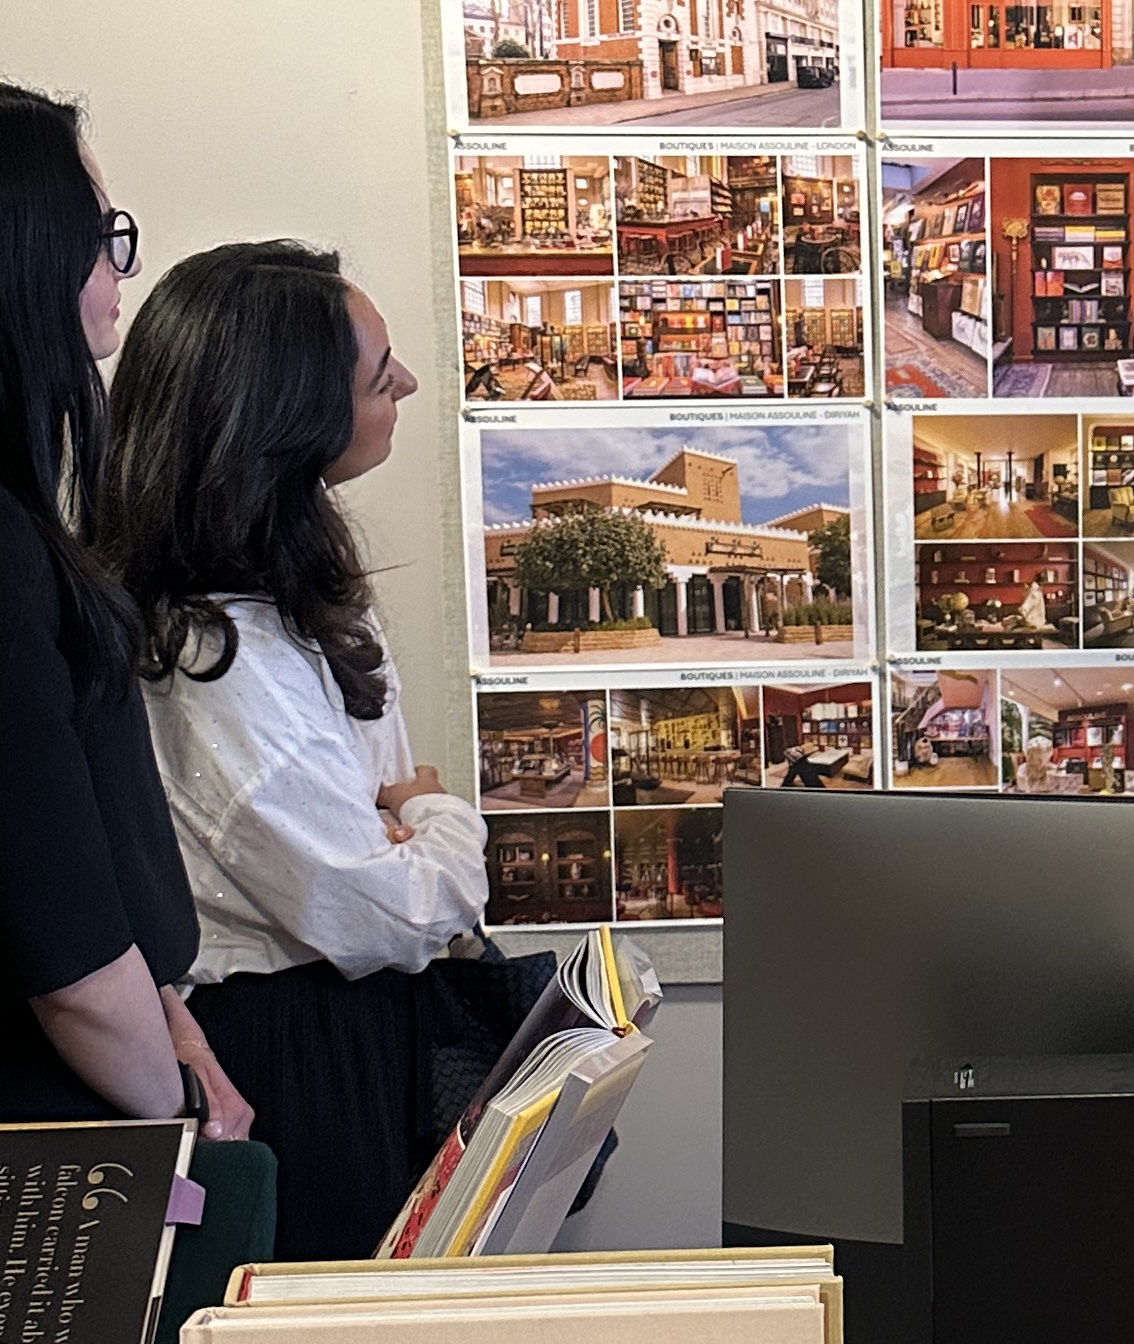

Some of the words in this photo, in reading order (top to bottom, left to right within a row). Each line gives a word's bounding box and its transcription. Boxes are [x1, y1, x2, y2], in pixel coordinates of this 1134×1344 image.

[659, 141, 714, 152] BOUTIQUES
[720, 141, 757, 151] MAISON
[759, 141, 809, 151] ASSOULINE
[816, 141, 857, 151] LONDON
[669, 412, 724, 422] BOUTIQUES
[729, 411, 766, 420] MAISON
[767, 410, 817, 420] ASSOULINE
[476, 676, 529, 686] ASSOULINE
[680, 671, 735, 682] BOUTIQUES
[739, 670, 776, 680] MAISON
[777, 669, 826, 680] ASSOULINE
[19, 1163, 47, 1207] with
[47, 1164, 82, 1222] falcon
[8, 1210, 40, 1255] him.
[2, 1258, 28, 1288] He
[30, 1224, 60, 1297] carried
[68, 1234, 91, 1278] man
[26, 1300, 52, 1315] it
[58, 1280, 85, 1325] who
